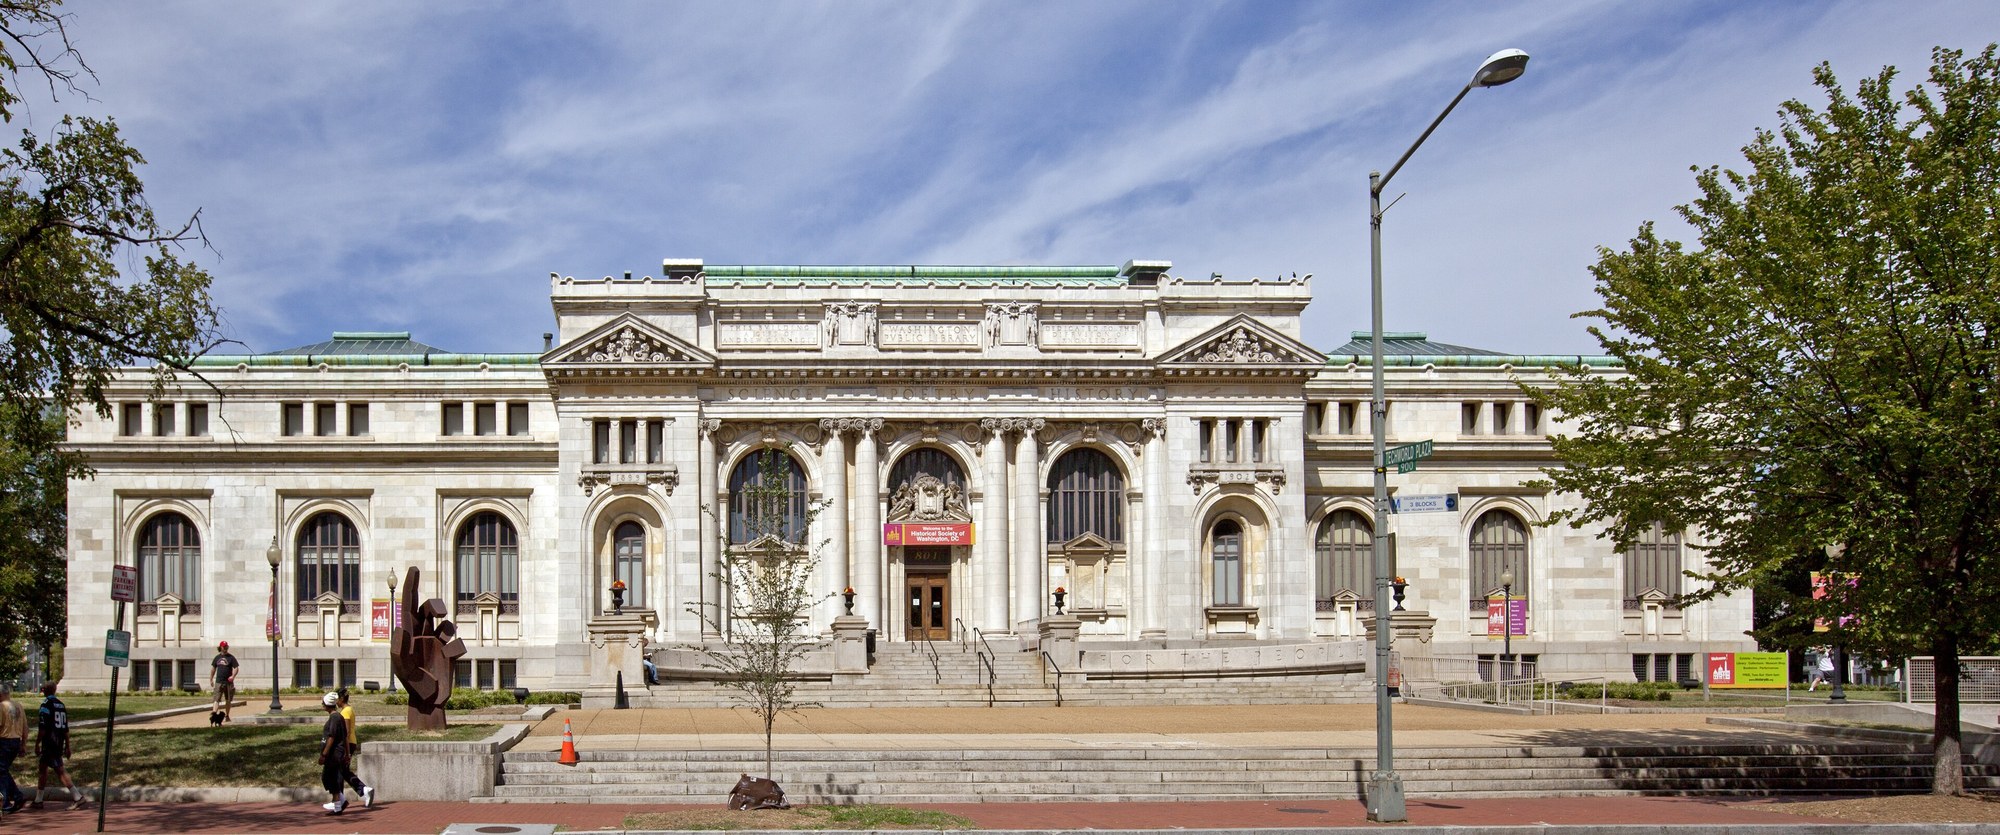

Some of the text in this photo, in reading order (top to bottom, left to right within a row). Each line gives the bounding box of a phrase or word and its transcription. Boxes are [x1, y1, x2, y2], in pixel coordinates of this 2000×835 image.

[888, 325, 971, 334] WASHINGTON
[929, 334, 976, 343] LIBRARY
[728, 388, 814, 400] SCIENCE
[891, 388, 974, 400] POETRY
[1051, 388, 1138, 400] HISTORY
[1415, 441, 1432, 459] PLAZA
[1400, 462, 1414, 472] 900
[915, 551, 938, 560] 801
[54, 711, 67, 729] 90
